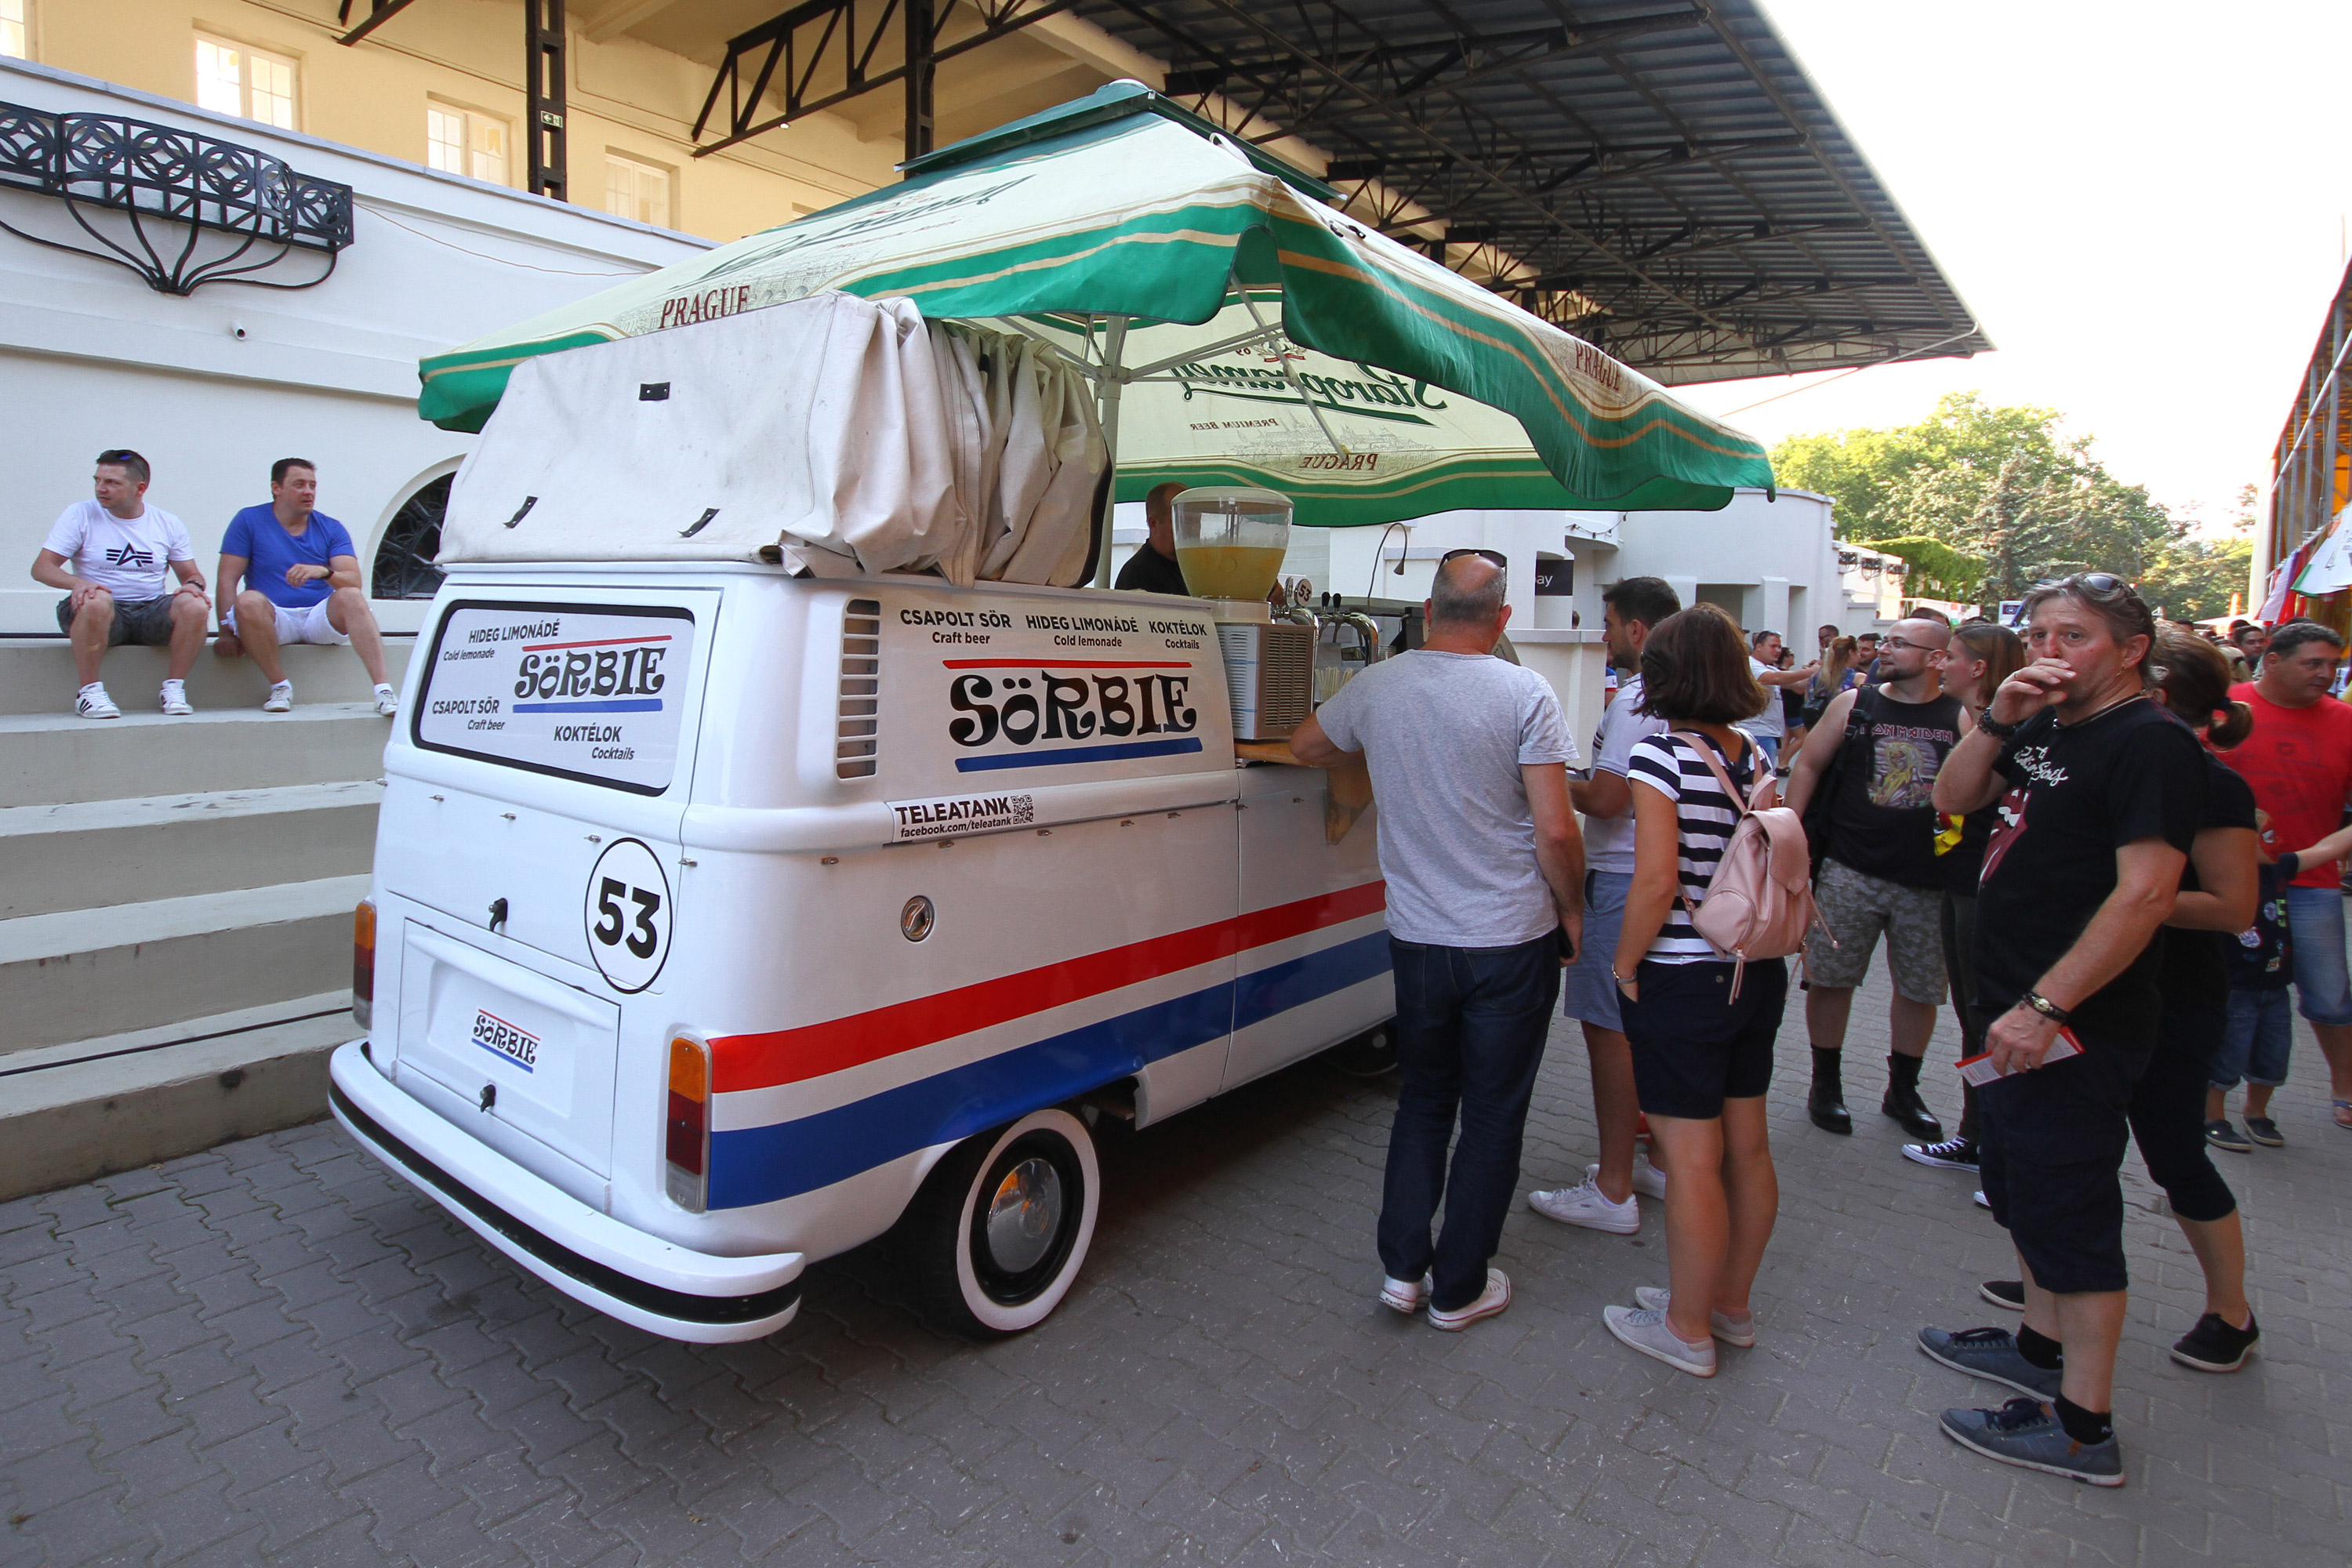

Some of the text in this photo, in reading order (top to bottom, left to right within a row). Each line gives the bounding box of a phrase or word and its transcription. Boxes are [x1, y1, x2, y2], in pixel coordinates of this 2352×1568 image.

[659, 285, 750, 328] PRAGUE
[1574, 340, 1621, 391] PRAGUE
[1535, 575, 1553, 587] ay
[1298, 584, 1312, 601] 53
[900, 609, 1012, 628] CSAPOLT SÖR
[1025, 615, 1139, 633] HIDEG LIMONÁDÉ
[468, 619, 560, 644] HIDEG LIMONÁDÉ
[1149, 619, 1207, 637] KOKTÉLOK
[932, 631, 990, 645] Craft beer
[1054, 635, 1122, 648] Cold lemonade
[1165, 638, 1200, 650] Cocktails
[443, 648, 495, 661] Cold lemonade
[432, 699, 477, 714] CSAPOLT
[467, 719, 506, 730] Craft beer
[554, 723, 622, 743] KOKTÉLOK
[1860, 722, 1953, 745] ION MAIDEN
[591, 746, 635, 760] Cocktails
[895, 797, 1011, 825] TELEATANK
[901, 817, 1011, 837] facebook.com/teleatank
[593, 877, 661, 959] 53
